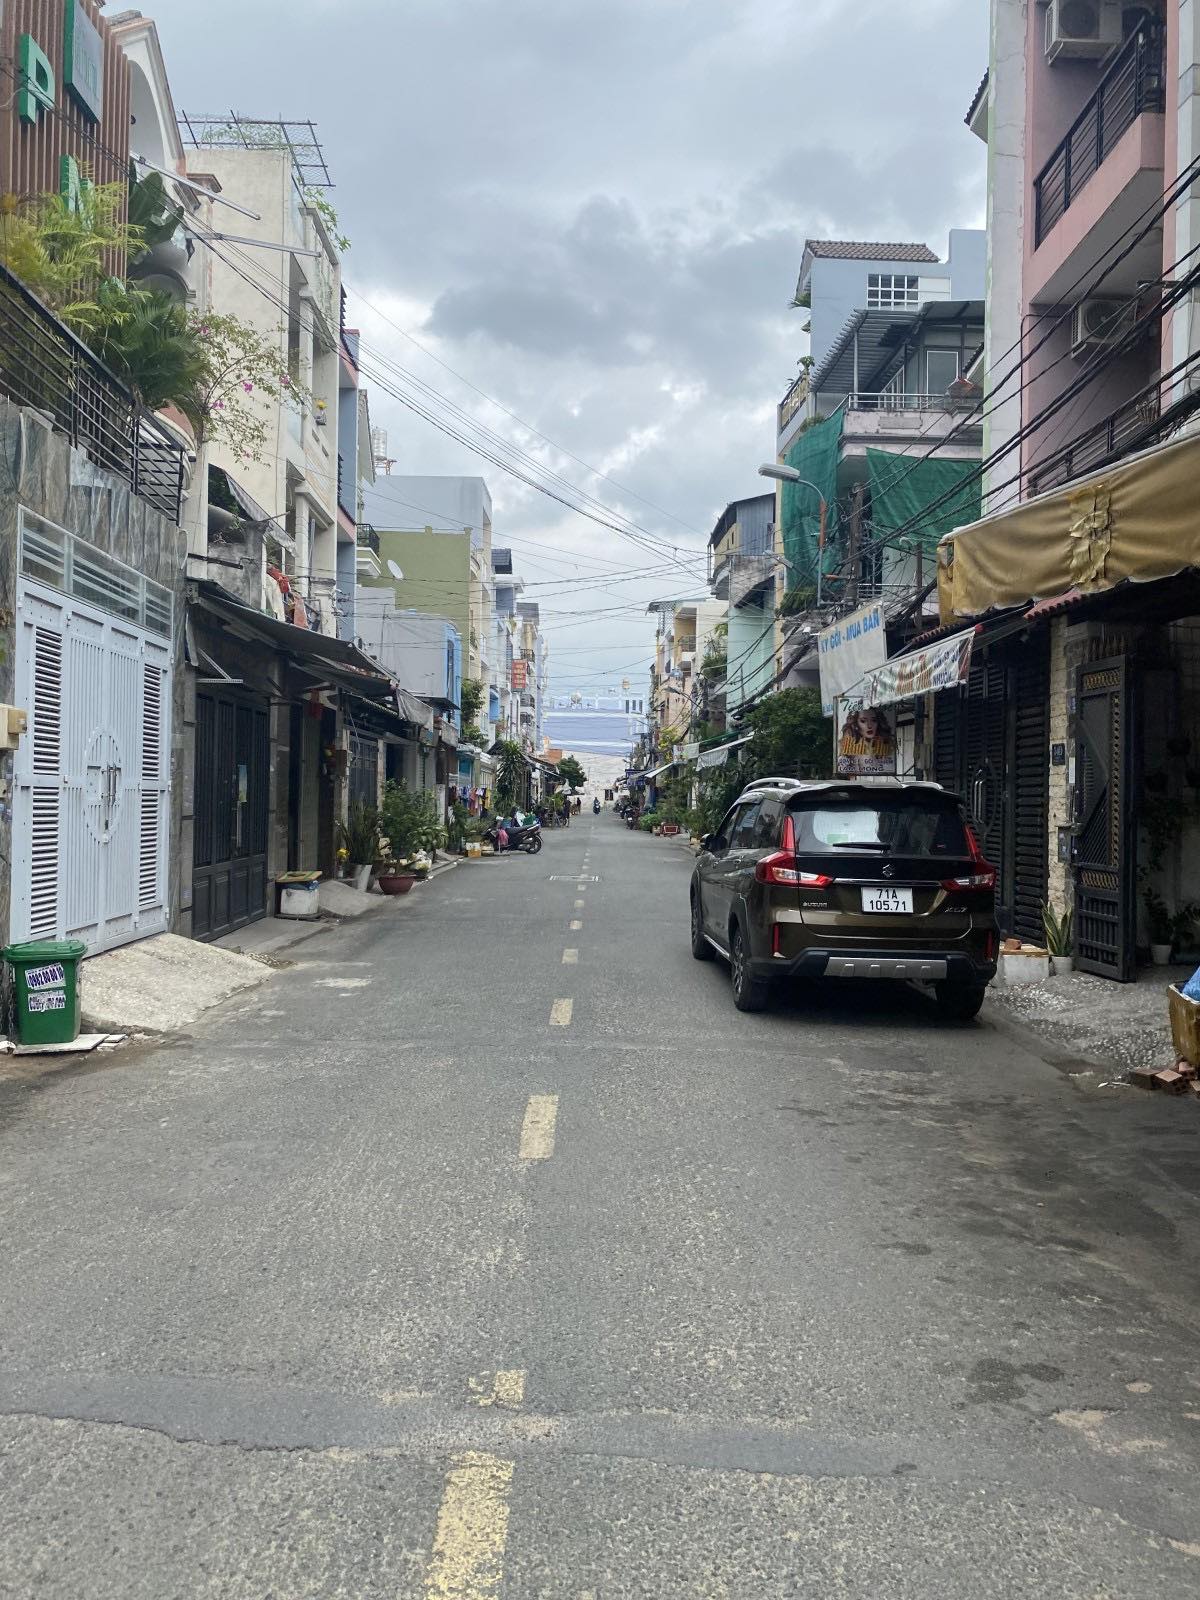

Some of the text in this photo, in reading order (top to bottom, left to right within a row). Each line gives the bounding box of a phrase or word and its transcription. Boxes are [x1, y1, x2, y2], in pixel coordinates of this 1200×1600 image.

[846, 621, 862, 641] MUA
[876, 888, 898, 900] 71A
[869, 900, 907, 911] 105.71
